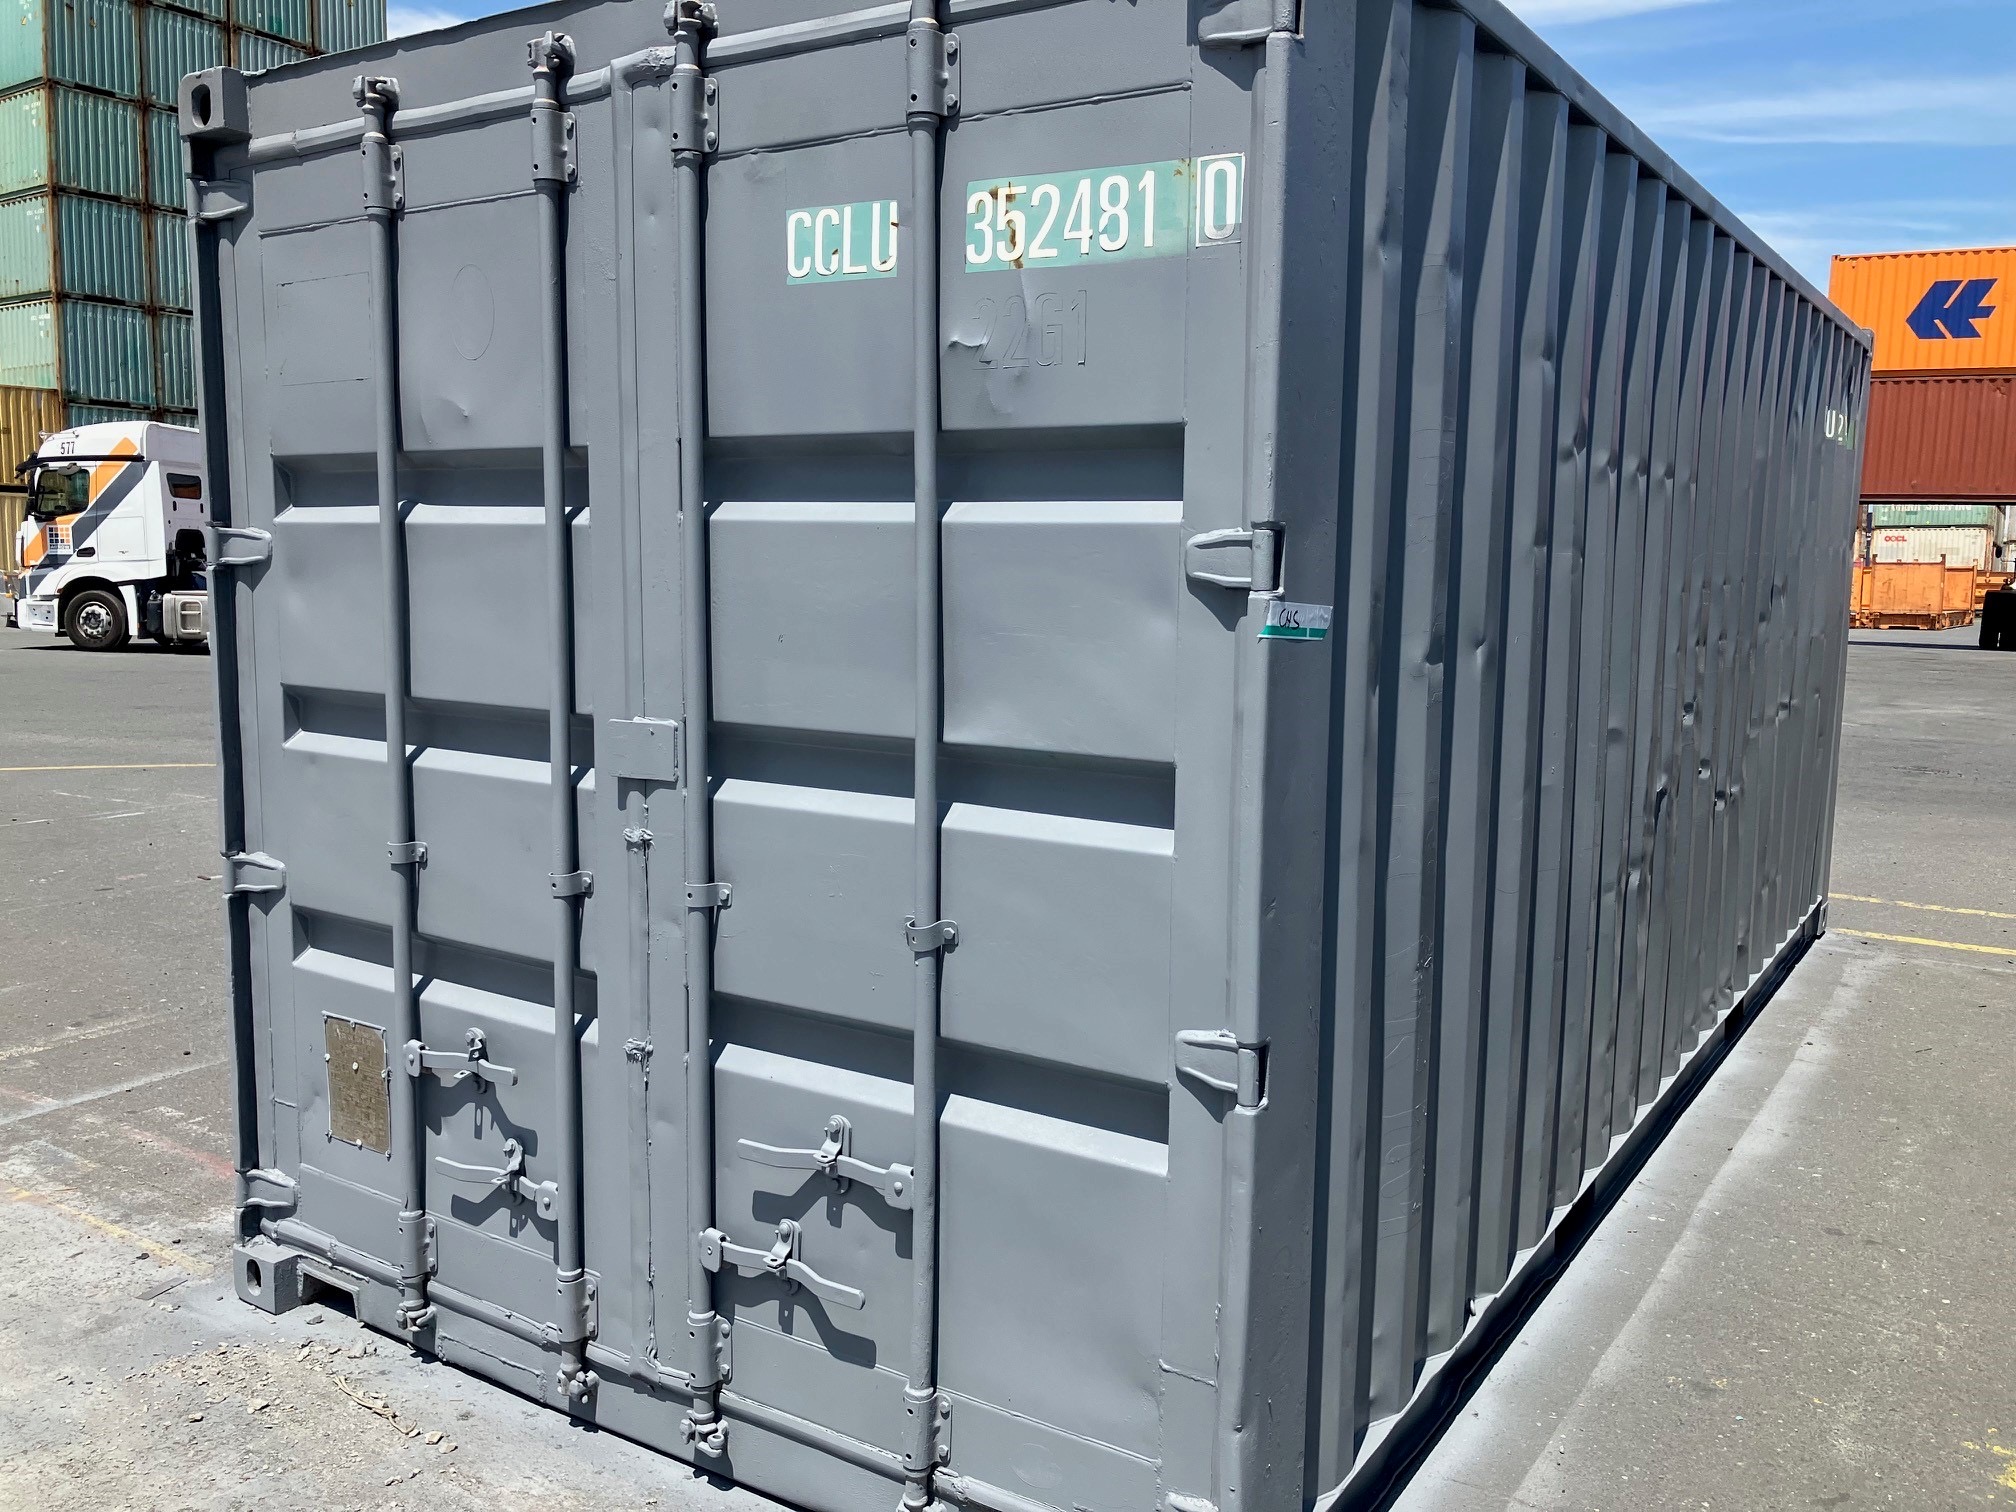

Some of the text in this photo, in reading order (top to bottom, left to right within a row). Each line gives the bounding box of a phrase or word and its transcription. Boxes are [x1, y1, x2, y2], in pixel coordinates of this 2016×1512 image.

[786, 159, 1236, 278] CCLU 352481 0
[972, 290, 1087, 370] 22G1
[60, 441, 75, 455] 577
[1884, 535, 1907, 543] OOCL
